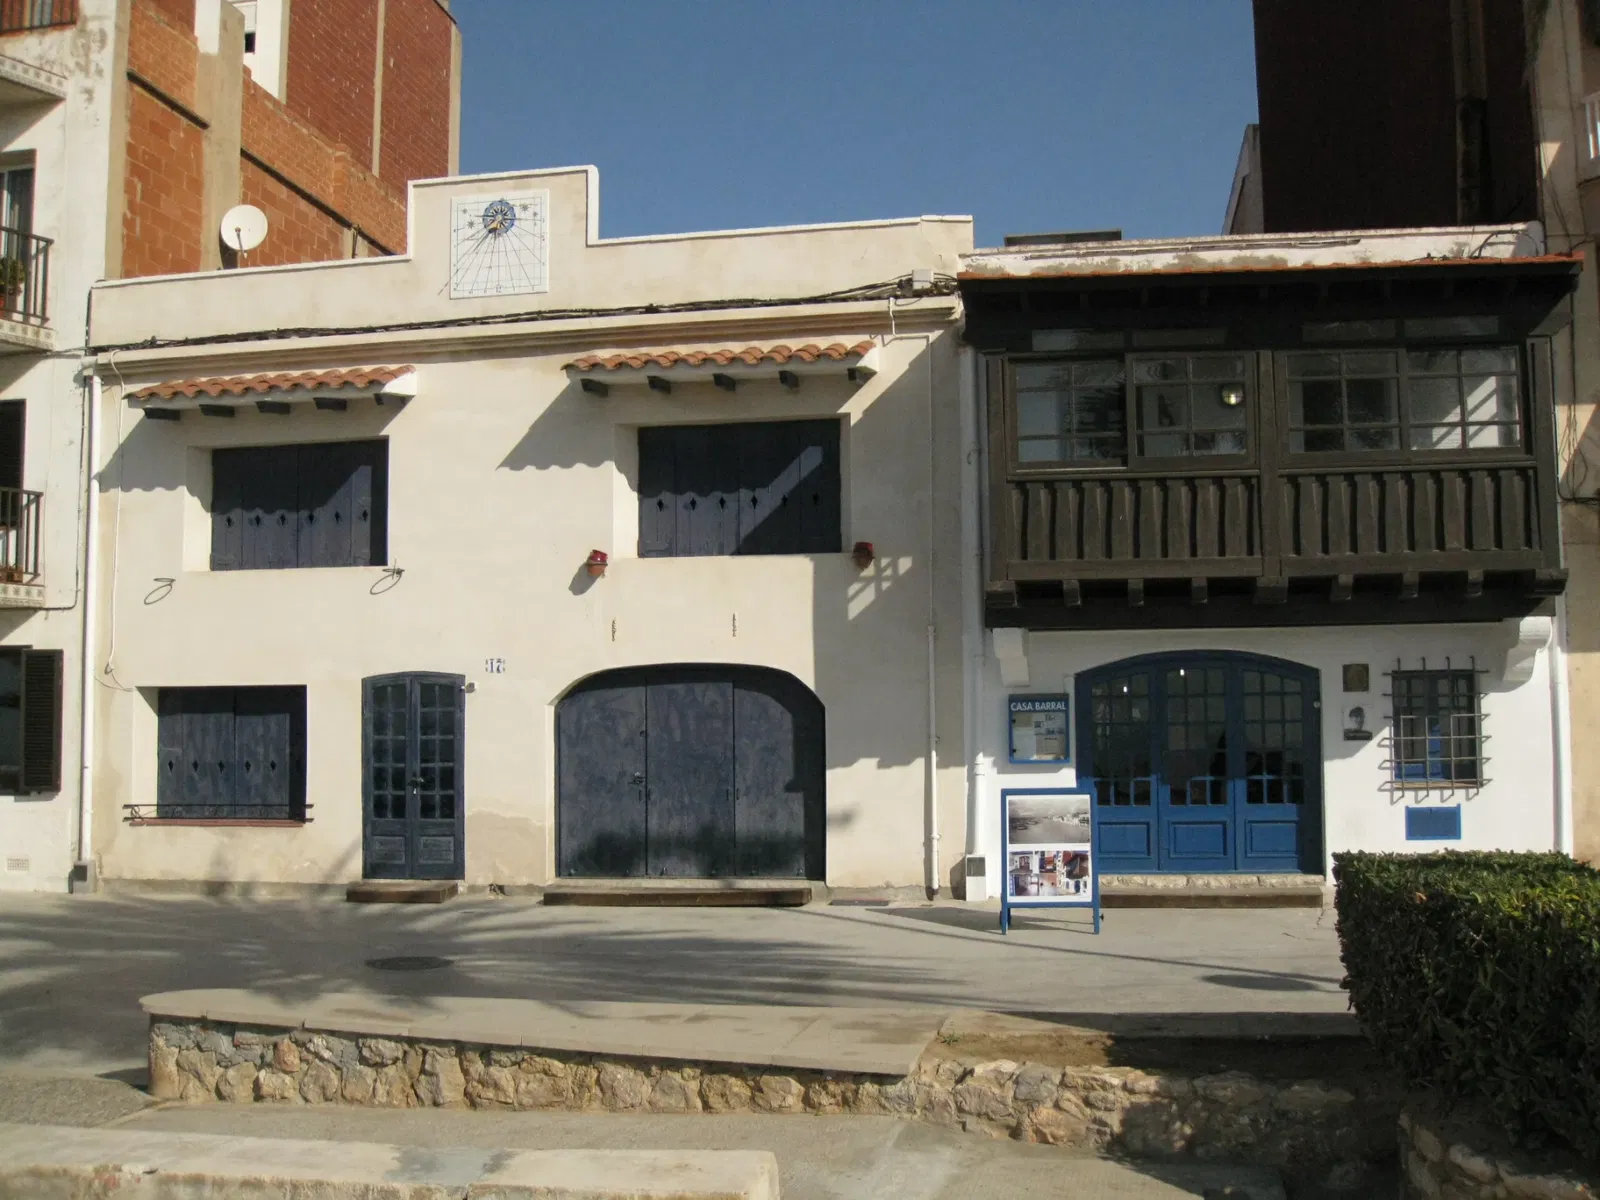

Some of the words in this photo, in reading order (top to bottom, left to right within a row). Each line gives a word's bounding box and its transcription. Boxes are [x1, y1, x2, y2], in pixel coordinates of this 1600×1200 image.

[489, 658, 502, 673] 17
[1010, 702, 1033, 711] CASA
[1035, 701, 1066, 710] BARRAL
